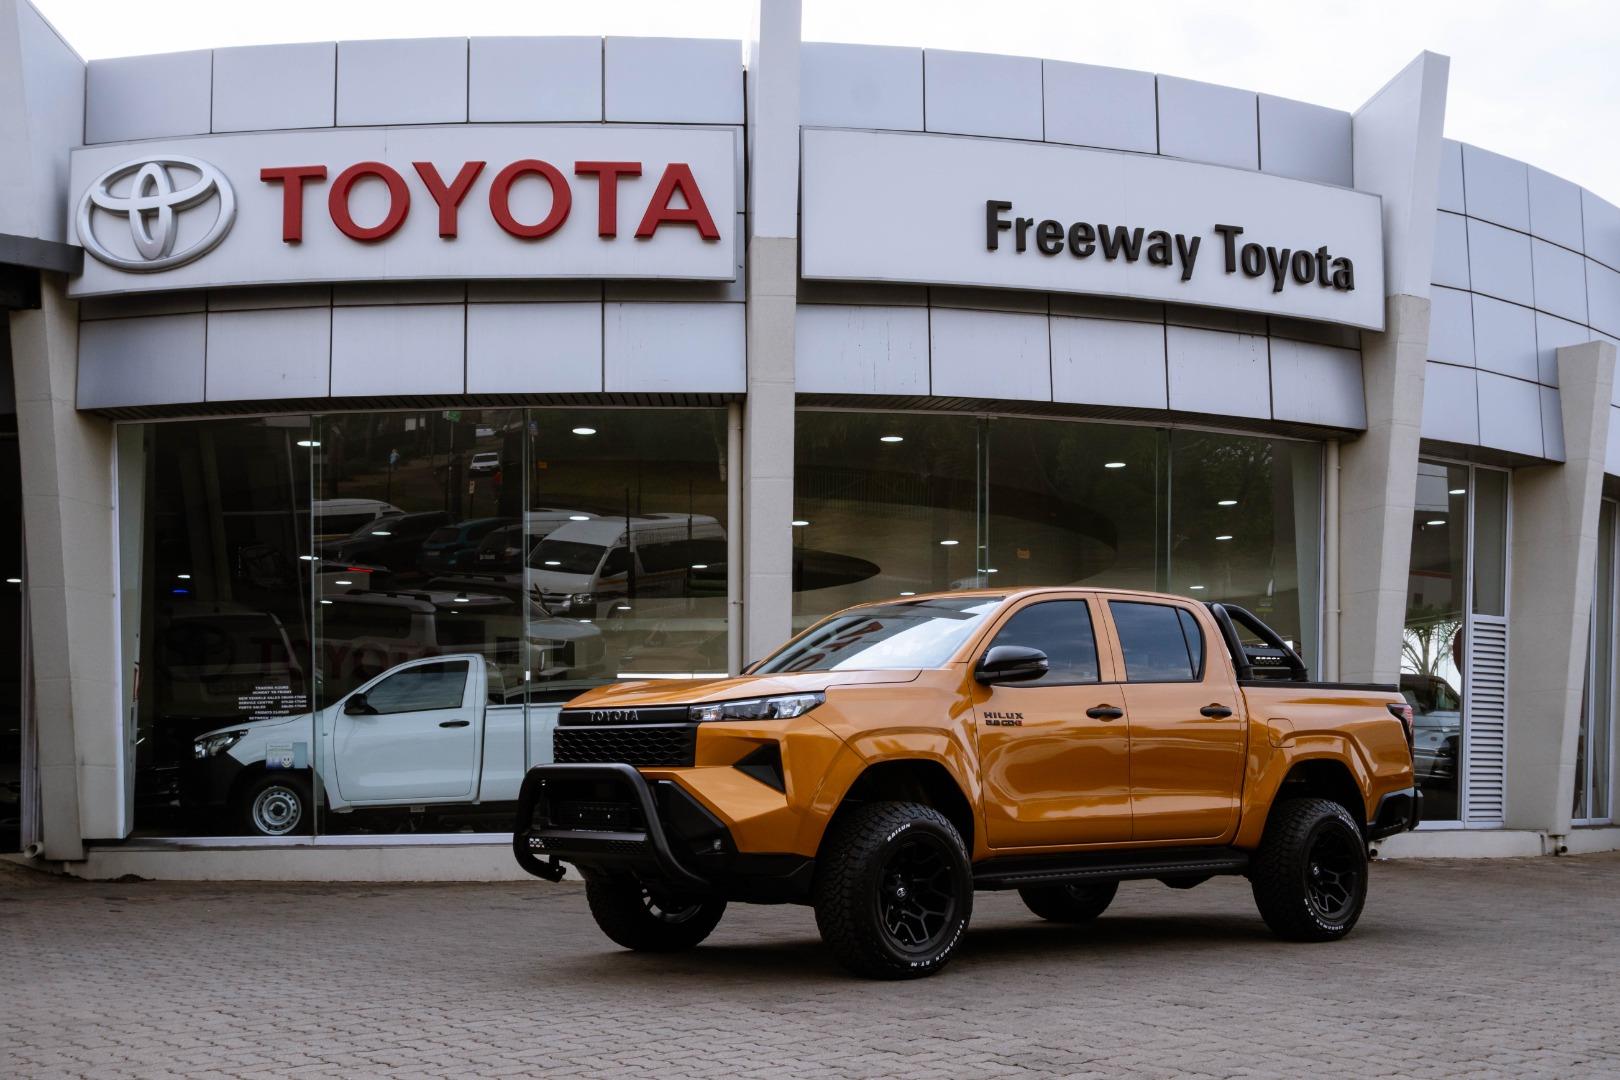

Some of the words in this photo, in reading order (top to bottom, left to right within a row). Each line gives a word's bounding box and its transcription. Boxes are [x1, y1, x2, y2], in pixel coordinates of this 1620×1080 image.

[260, 158, 721, 245] TOYOTA
[986, 199, 1201, 281] Freeway
[1215, 223, 1355, 292] Toyota
[589, 710, 639, 721] TOYOTA
[984, 711, 1024, 719] HILUX
